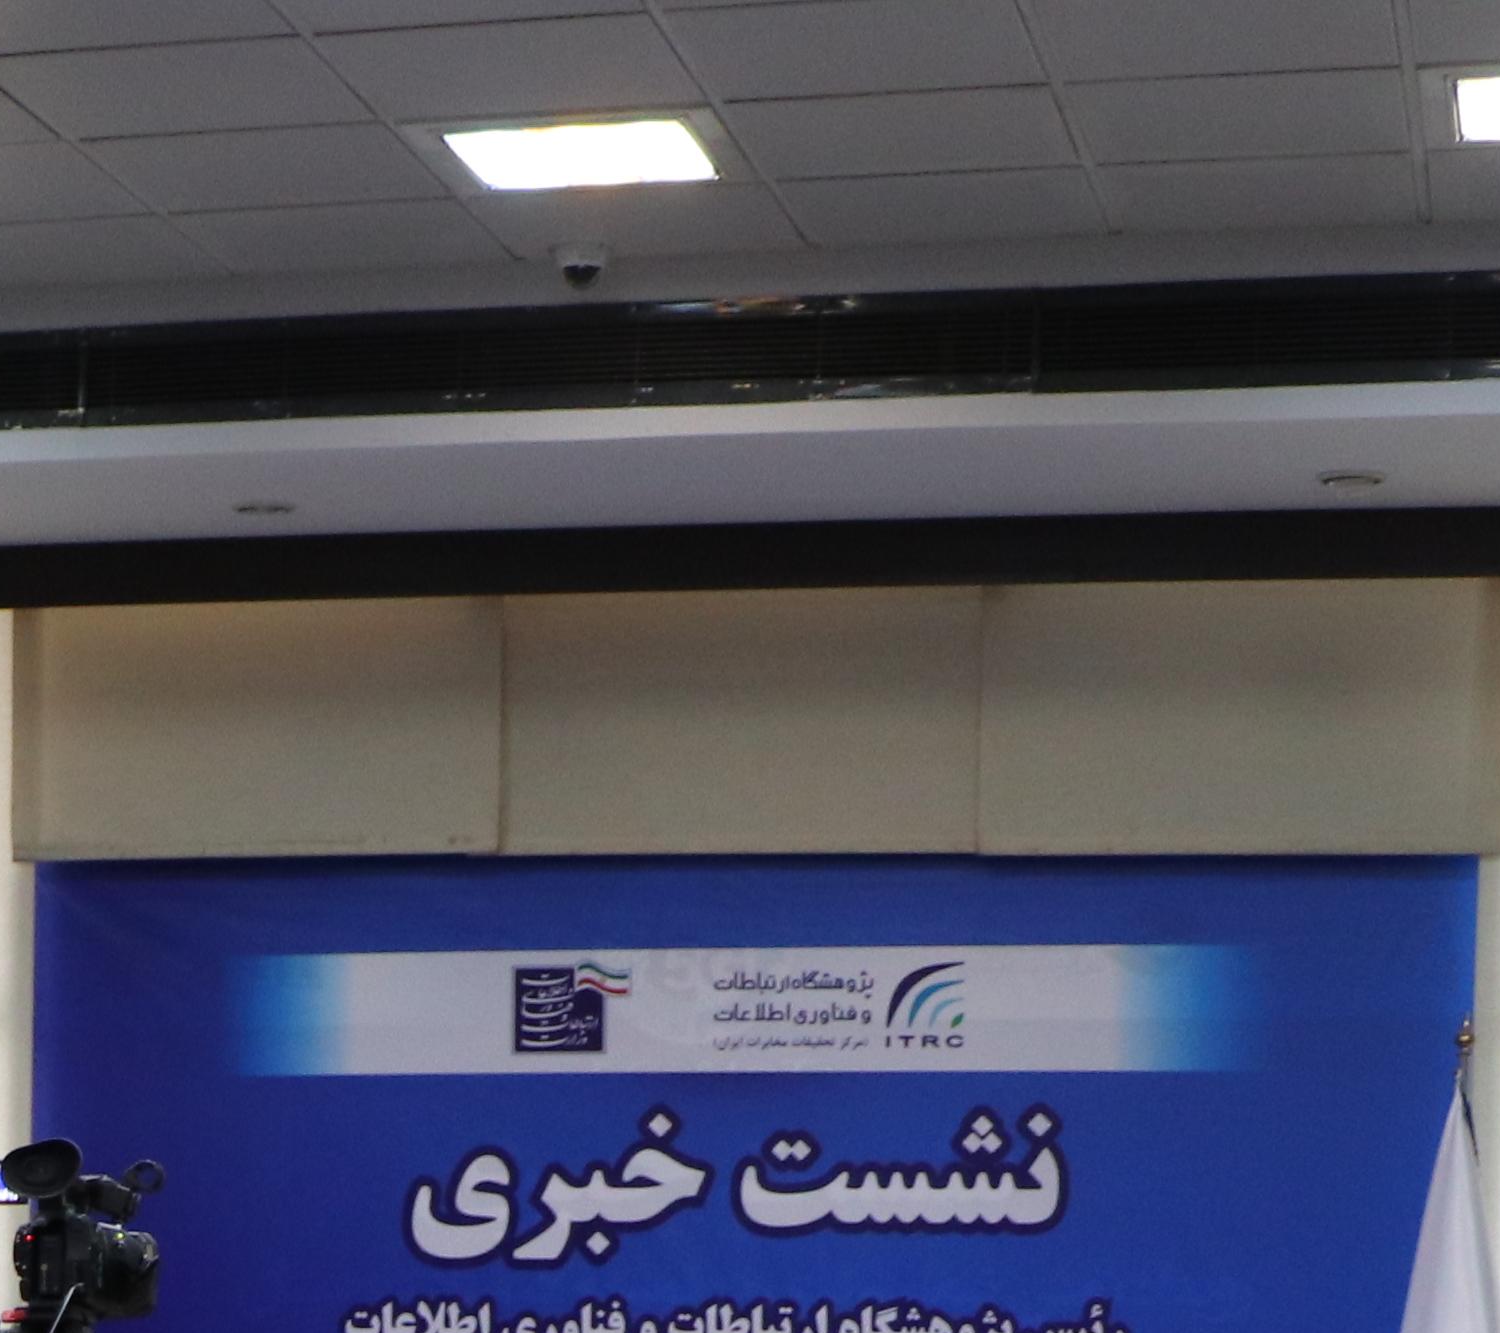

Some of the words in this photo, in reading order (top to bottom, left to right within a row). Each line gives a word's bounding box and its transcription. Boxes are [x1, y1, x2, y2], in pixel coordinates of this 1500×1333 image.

[712, 970, 790, 995] ارتباطات
[792, 970, 874, 1000] پژوهشگاه
[712, 1001, 792, 1023] اطلاعات
[792, 1003, 858, 1027] فناوری
[860, 1010, 872, 1026] و
[884, 1034, 965, 1049] ITRC
[740, 1113, 1060, 1228] نشست
[411, 1113, 706, 1261] خبری
